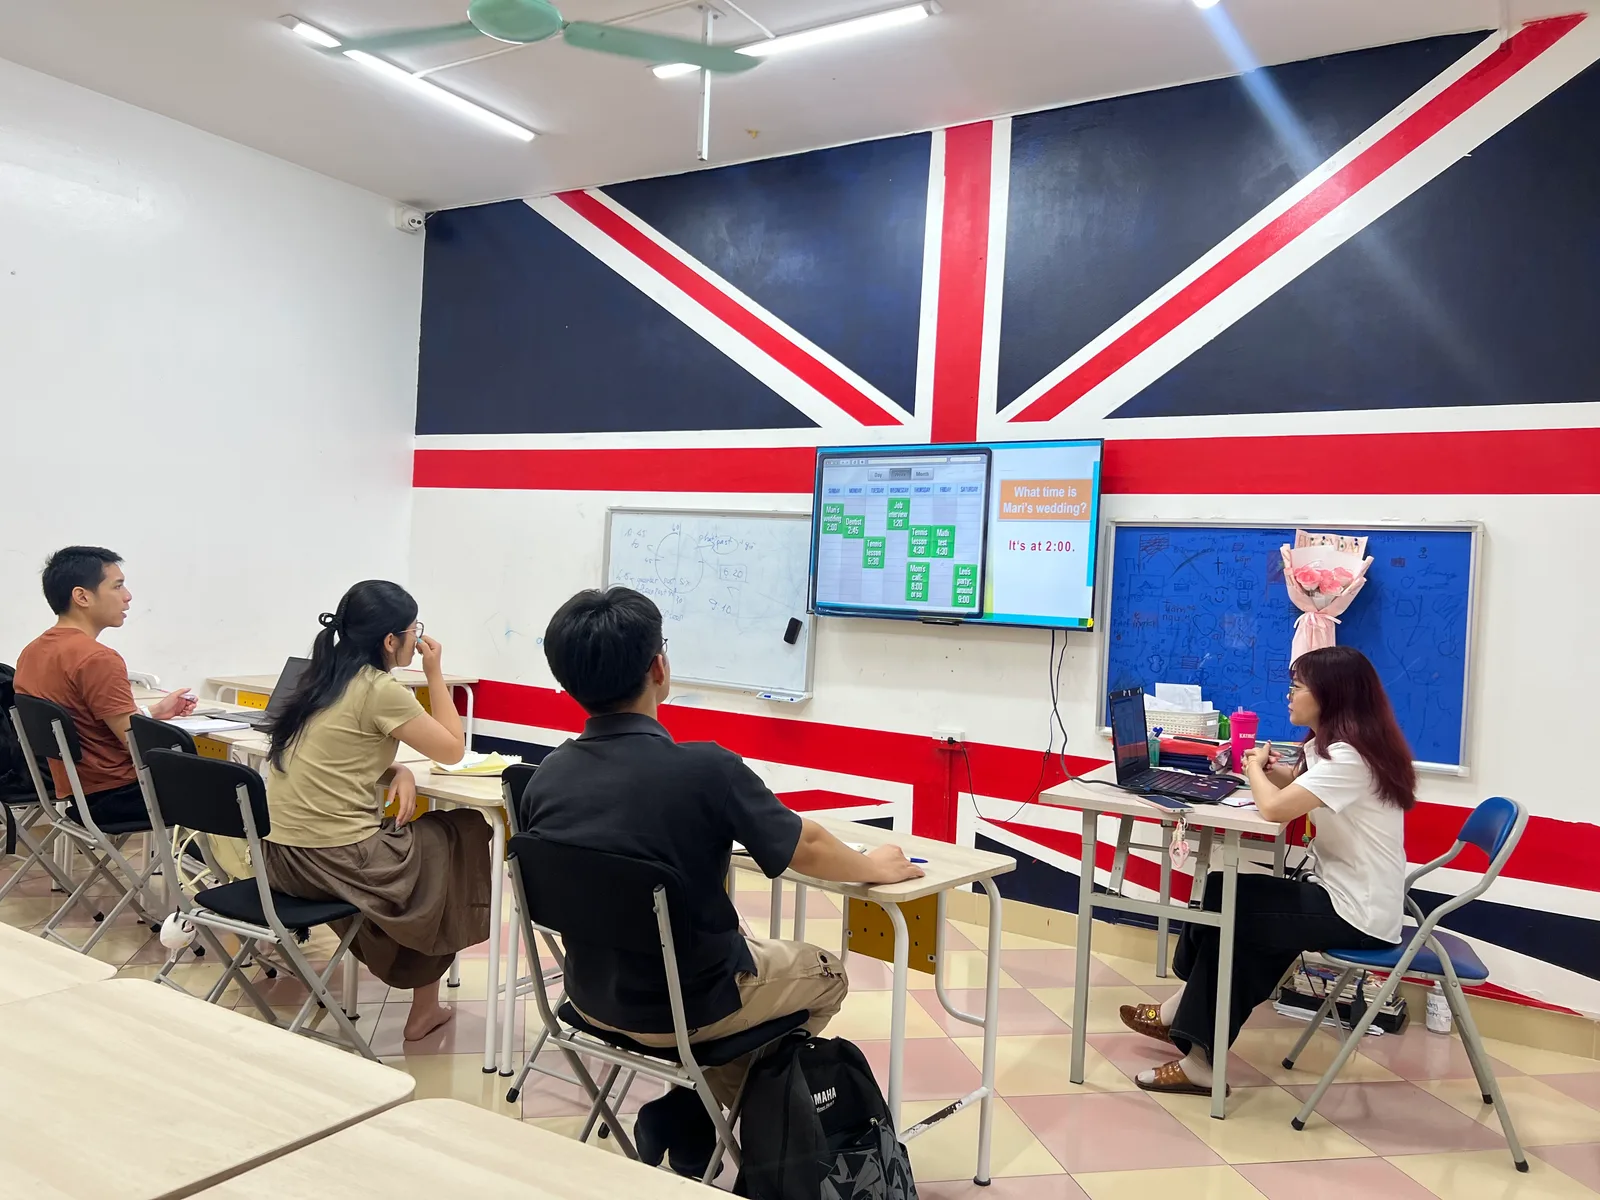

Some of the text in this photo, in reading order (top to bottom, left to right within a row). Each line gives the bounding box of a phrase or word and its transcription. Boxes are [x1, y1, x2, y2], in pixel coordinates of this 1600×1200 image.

[1014, 486, 1077, 497] What time is
[893, 501, 904, 509] Job
[1003, 502, 1087, 516] Mari's wedding?
[888, 510, 908, 518] interview
[823, 514, 842, 523] wedding
[845, 517, 862, 526] Dentist
[826, 523, 838, 531] 2:00
[847, 526, 859, 535] 2:45
[912, 528, 928, 536] Tennis
[936, 529, 950, 537] Math
[867, 539, 882, 547] Tennis
[911, 537, 928, 545] lesson
[912, 546, 925, 554] 4:30
[1008, 540, 1075, 552] It's at 2:00.
[866, 548, 882, 556] lesson
[936, 547, 948, 555] 4:30
[909, 565, 926, 573] Mom's
[956, 587, 973, 595] around
